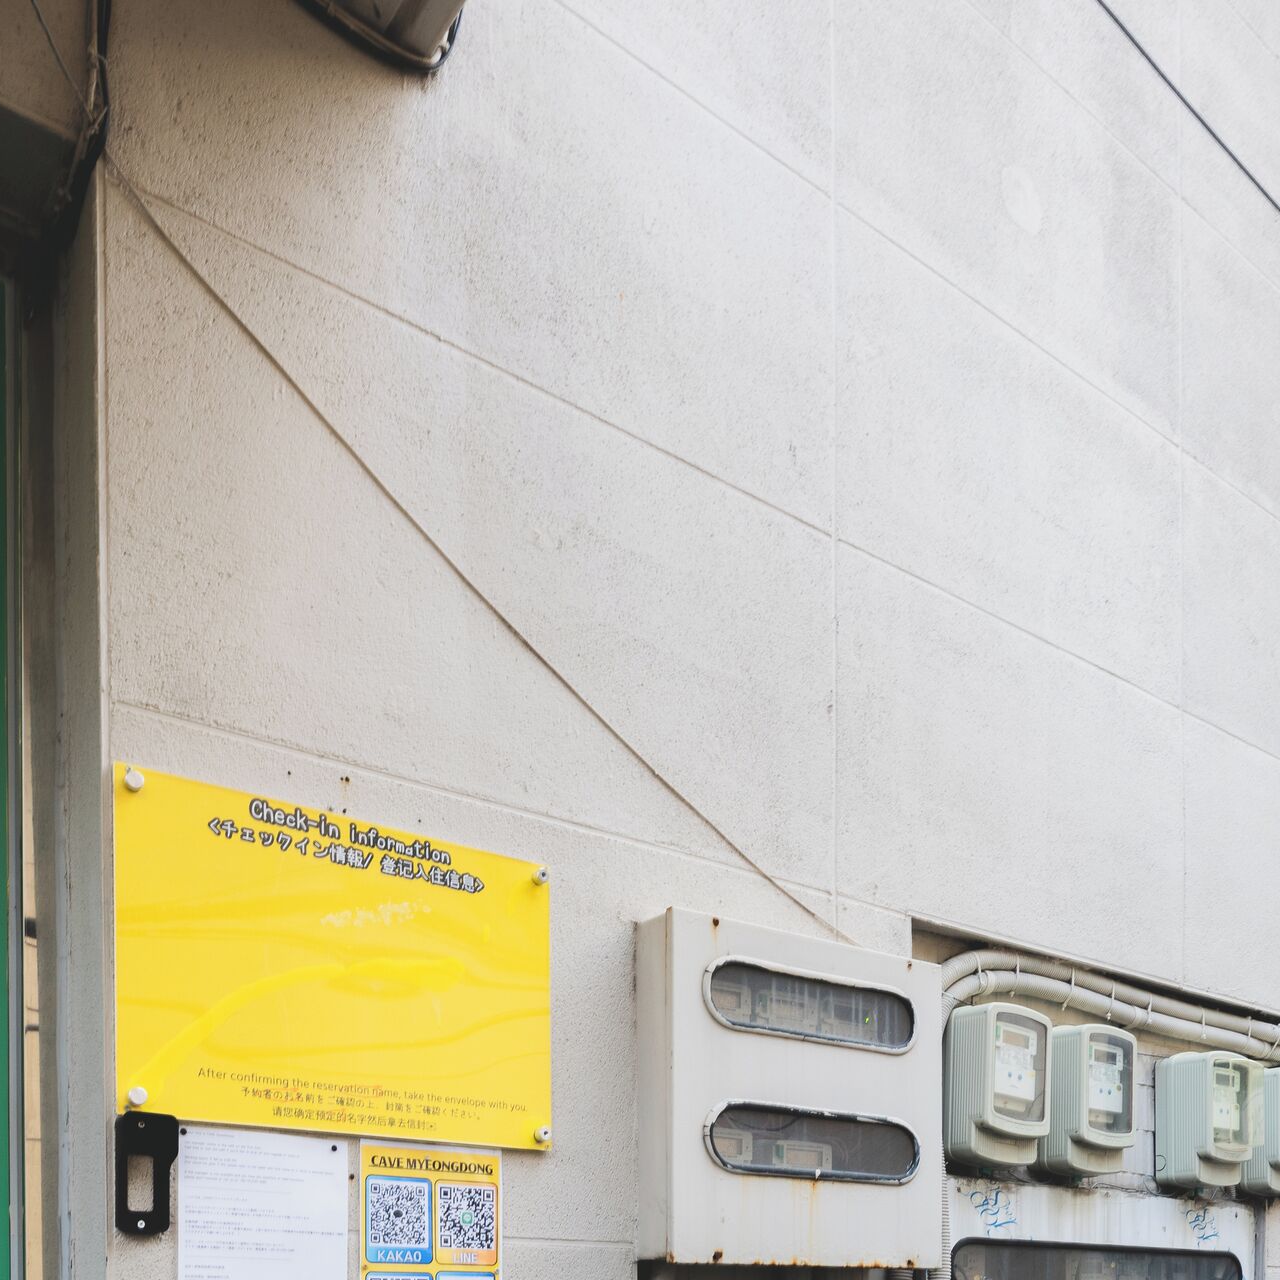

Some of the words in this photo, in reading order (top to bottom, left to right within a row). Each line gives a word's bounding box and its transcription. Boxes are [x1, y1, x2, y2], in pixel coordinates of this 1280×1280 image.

[249, 799, 340, 839] Check-in
[349, 823, 451, 866] information
[198, 1067, 227, 1081] After
[230, 1073, 289, 1089] confirming
[292, 1077, 310, 1089] the
[312, 1082, 370, 1095] reservation
[404, 1091, 424, 1101] take
[427, 1094, 443, 1104] the
[445, 1096, 486, 1109] envelope
[488, 1099, 508, 1110] with
[371, 1155, 404, 1169] CAVE
[406, 1158, 493, 1175] MYEONGDONG
[377, 1249, 422, 1264] KAKAO
[452, 1252, 478, 1265] LINE
